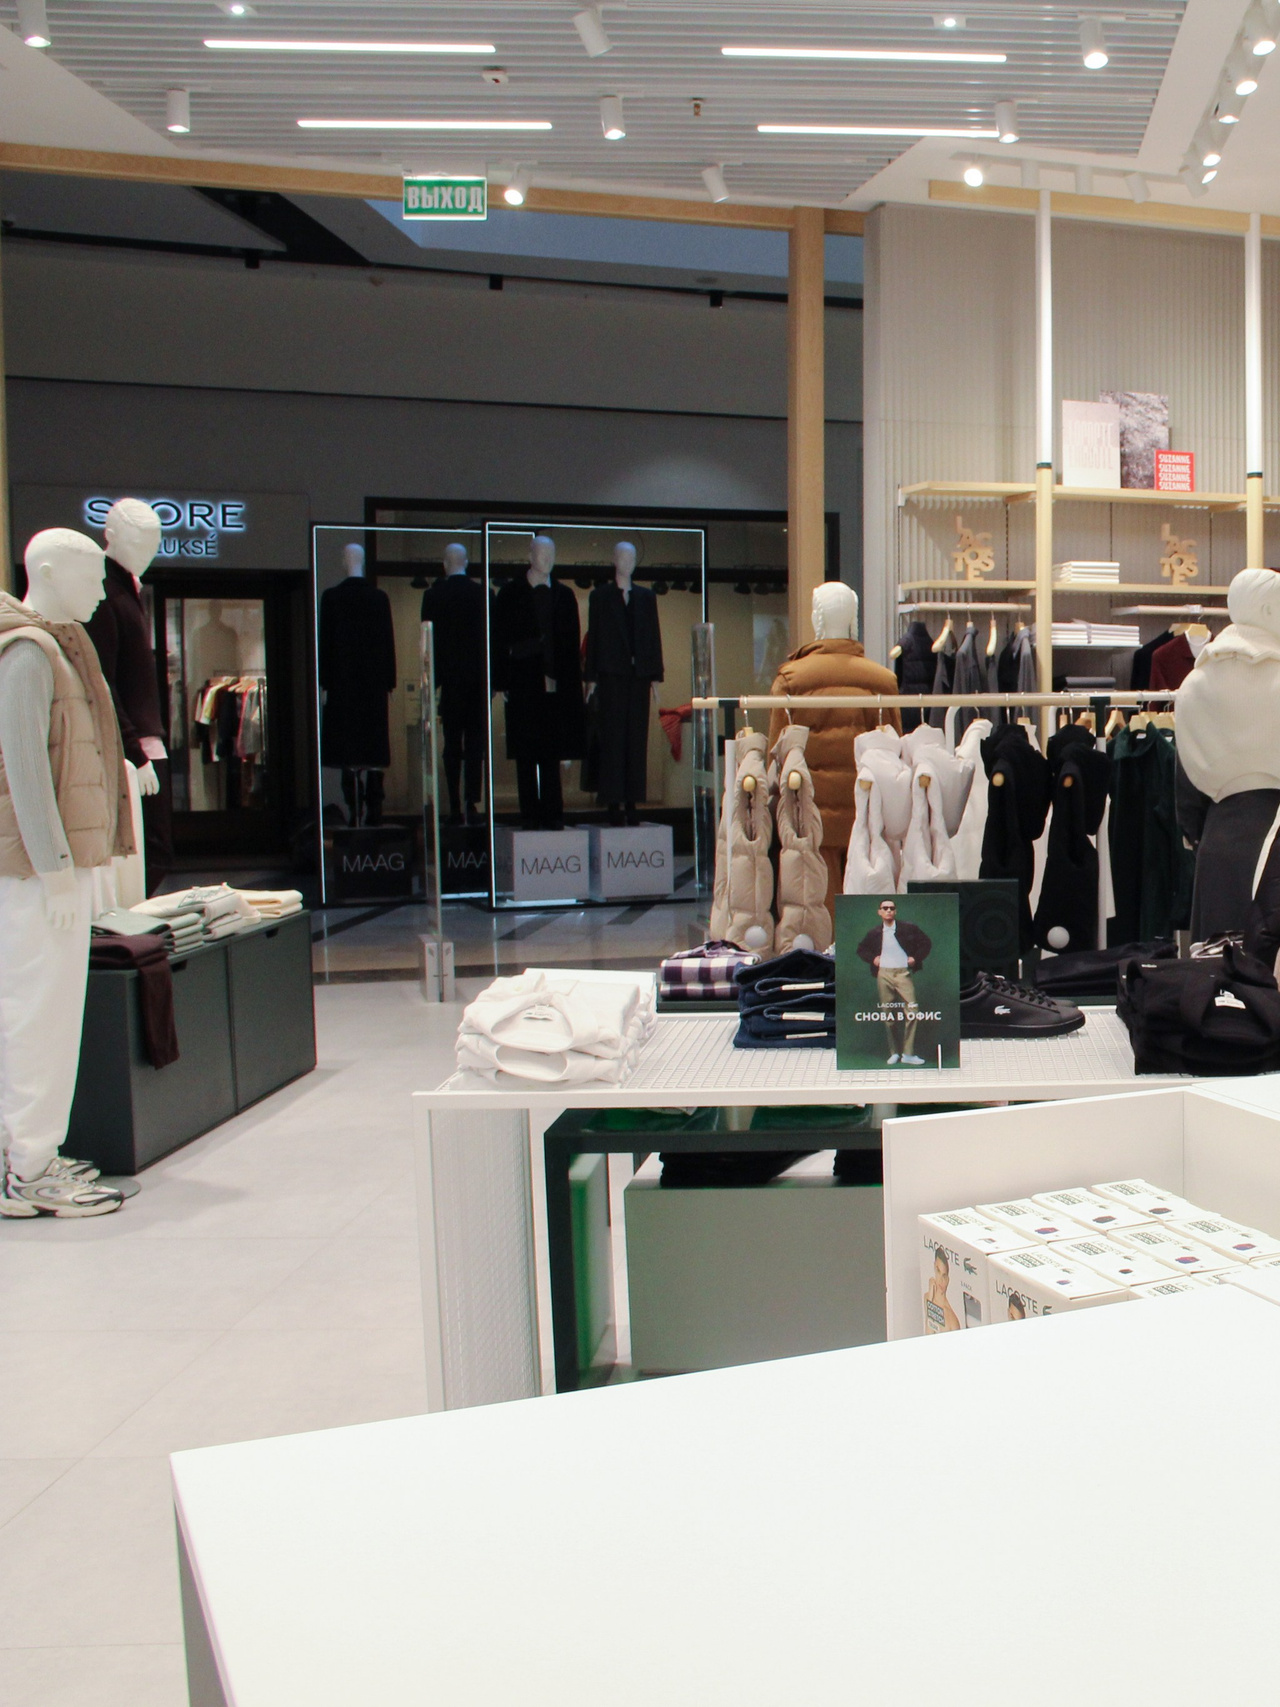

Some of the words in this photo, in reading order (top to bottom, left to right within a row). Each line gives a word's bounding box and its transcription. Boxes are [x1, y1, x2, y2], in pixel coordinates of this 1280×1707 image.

[407, 186, 483, 213] ВЫХОД
[86, 498, 244, 529] SORE
[158, 533, 217, 556] UKSÉ
[343, 853, 405, 872] MAAG
[448, 851, 488, 869] MAA
[521, 855, 581, 875] MAAG
[607, 851, 665, 869] MAAG
[855, 1011, 895, 1022] СНОВА
[897, 1011, 904, 1021] В
[907, 1011, 942, 1021] ОФИС
